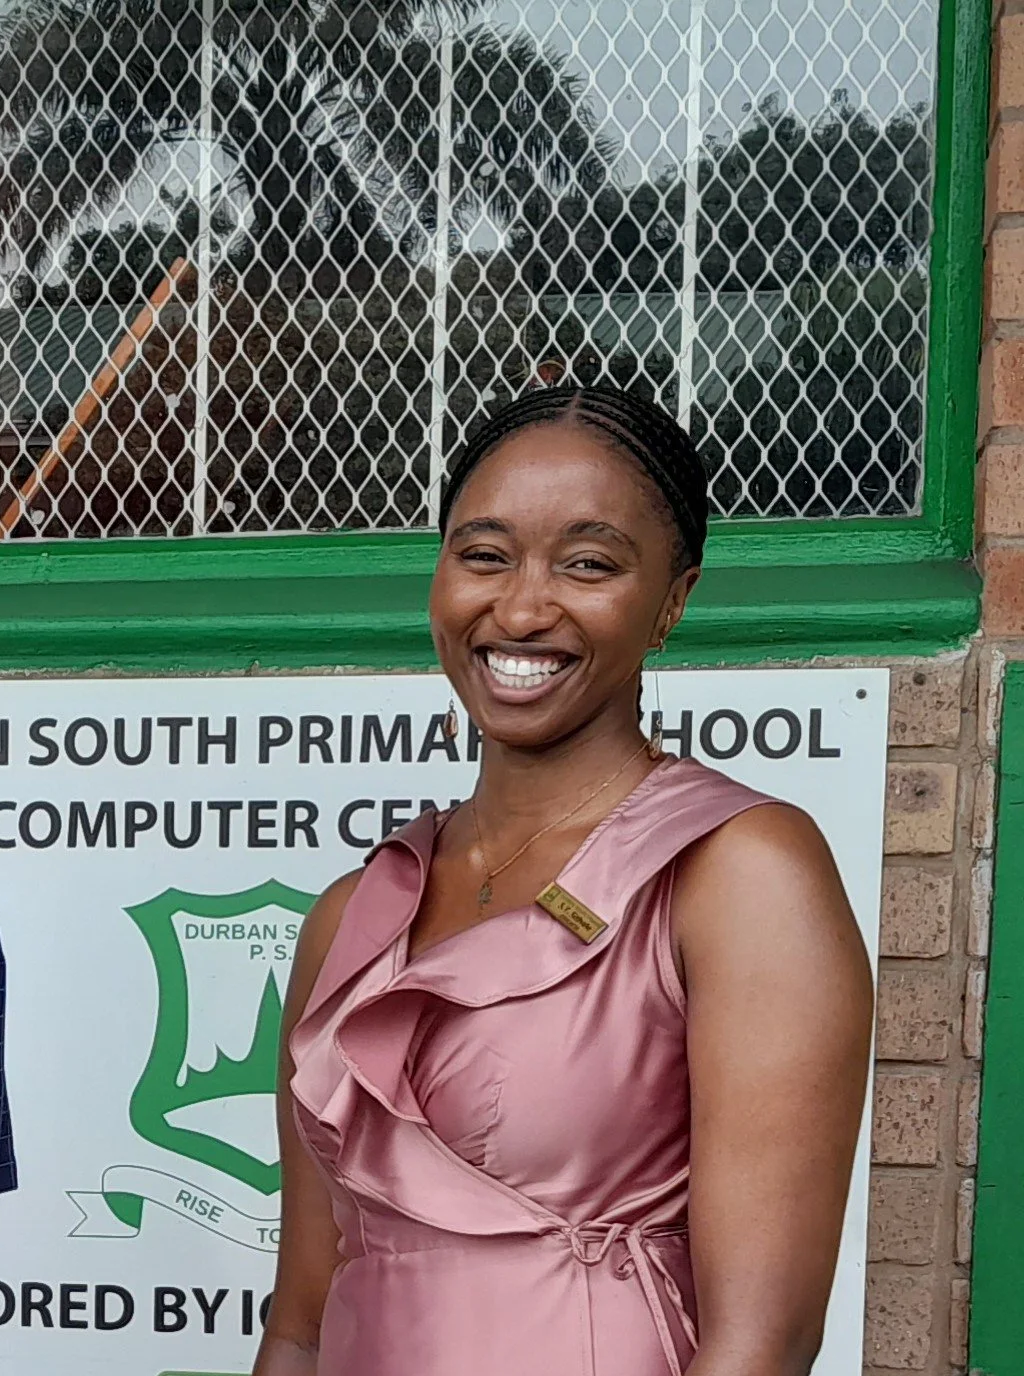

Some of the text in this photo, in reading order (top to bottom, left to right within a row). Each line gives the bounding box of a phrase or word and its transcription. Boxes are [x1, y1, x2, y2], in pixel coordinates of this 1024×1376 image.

[28, 716, 237, 766] SOUTH
[337, 799, 463, 849] CE
[185, 923, 277, 940] DURBAN
[249, 944, 266, 960] P.
[175, 1189, 225, 1224] RISE
[153, 1286, 230, 1334] BY
